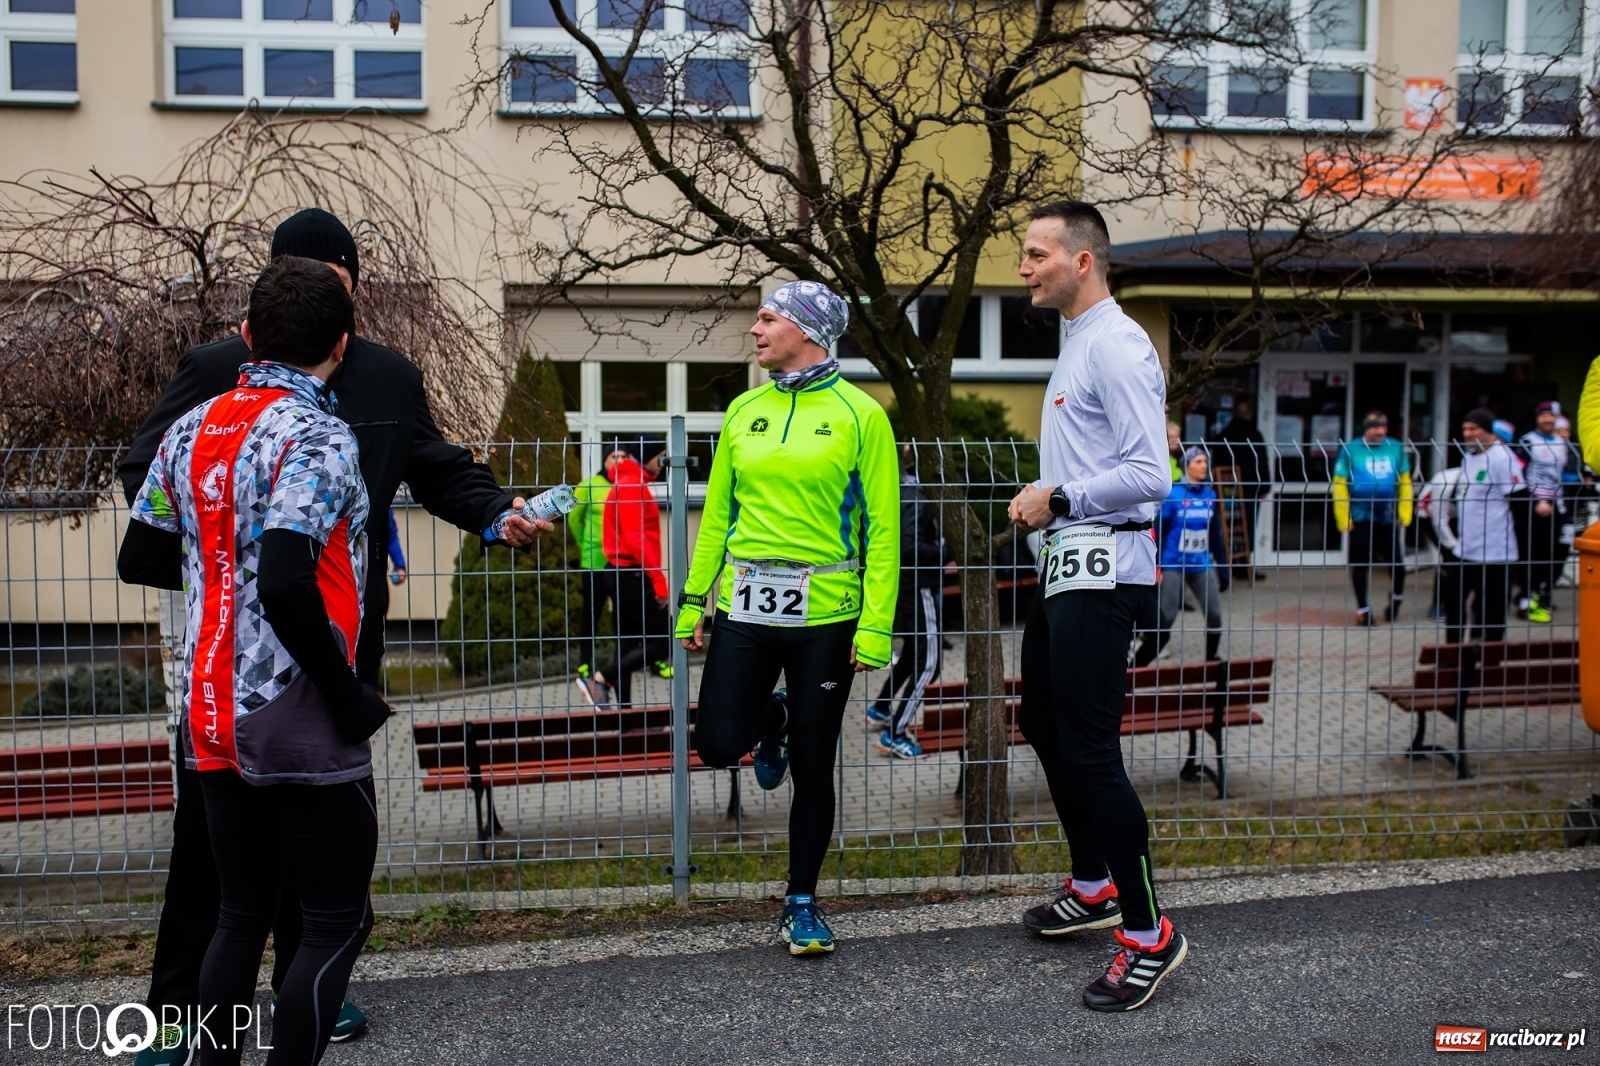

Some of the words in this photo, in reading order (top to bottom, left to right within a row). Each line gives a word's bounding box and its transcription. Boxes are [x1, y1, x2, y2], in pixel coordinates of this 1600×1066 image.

[1048, 547, 1111, 586] 256
[204, 536, 232, 675] SPORTOW
[738, 584, 803, 616] 132
[820, 681, 838, 690] 4F
[202, 681, 220, 745] KLUB
